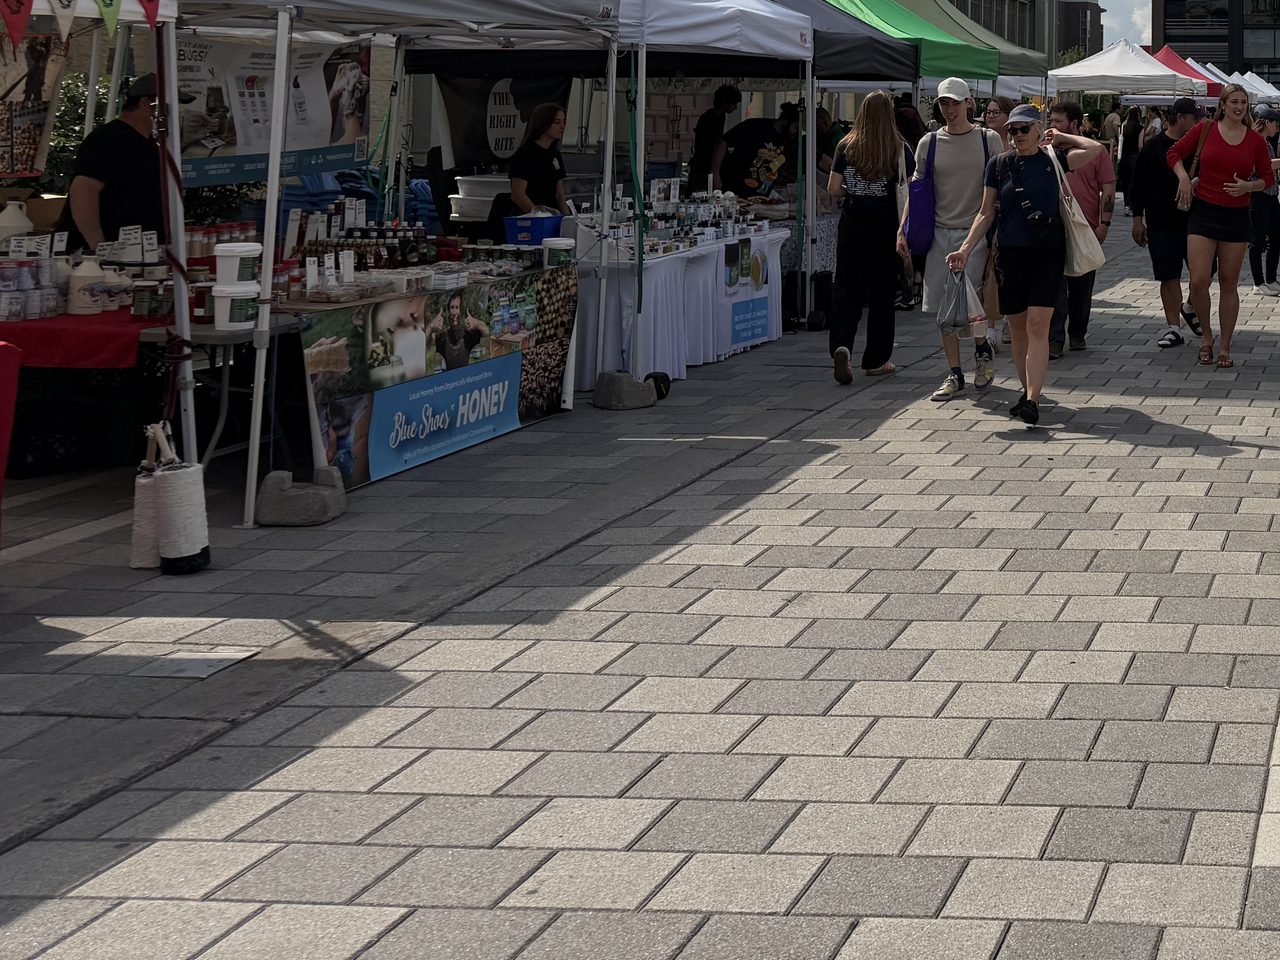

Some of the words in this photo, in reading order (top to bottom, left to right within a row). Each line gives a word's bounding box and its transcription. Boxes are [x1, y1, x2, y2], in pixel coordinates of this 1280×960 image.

[178, 49, 208, 62] BUGS!
[492, 92, 511, 106] THE
[489, 114, 517, 129] RIGHT
[494, 137, 515, 152] BITE
[390, 411, 418, 449] Blue
[419, 403, 450, 439] Shoes
[456, 381, 509, 428] HONEY
